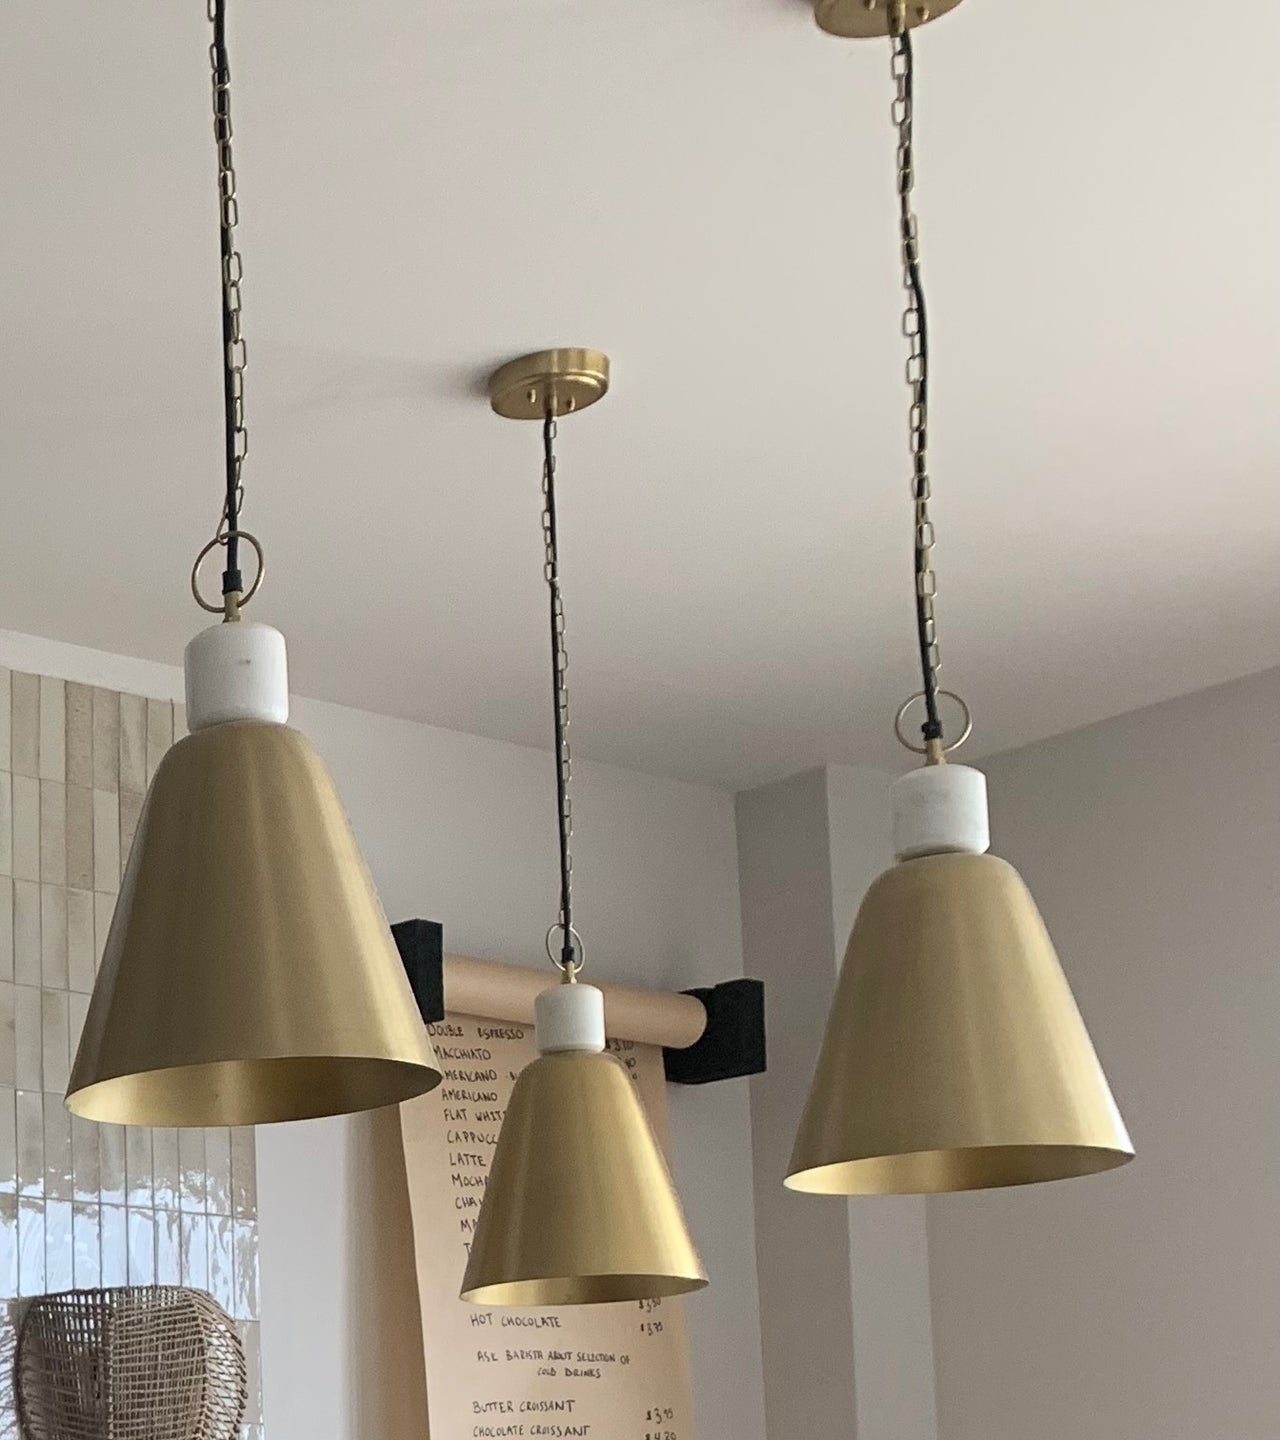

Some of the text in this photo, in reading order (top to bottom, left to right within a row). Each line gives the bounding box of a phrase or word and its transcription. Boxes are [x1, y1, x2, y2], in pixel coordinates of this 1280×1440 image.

[427, 1023, 464, 1036] DOUBLE
[477, 1027, 524, 1040] ESPRESSO
[433, 1045, 492, 1060] MACCHIATO
[443, 1069, 498, 1082] MERICANO
[442, 1088, 498, 1102] AMERICANO
[444, 1108, 507, 1122] FLAT WHIT
[447, 1130, 498, 1144] CAPPUCC
[449, 1152, 486, 1167] LATTE
[470, 1313, 493, 1328] HOT
[501, 1316, 562, 1328] CHOCOLATE
[477, 1350, 630, 1365] ASK BARISTA ABOUT SELECTION OF
[537, 1367, 601, 1378] COLD DRINKS
[472, 1400, 514, 1414] BUTTER
[519, 1399, 576, 1413] CROISSANT
[473, 1424, 524, 1438] CHOCOLATE
[530, 1425, 590, 1438] CROISSANT
